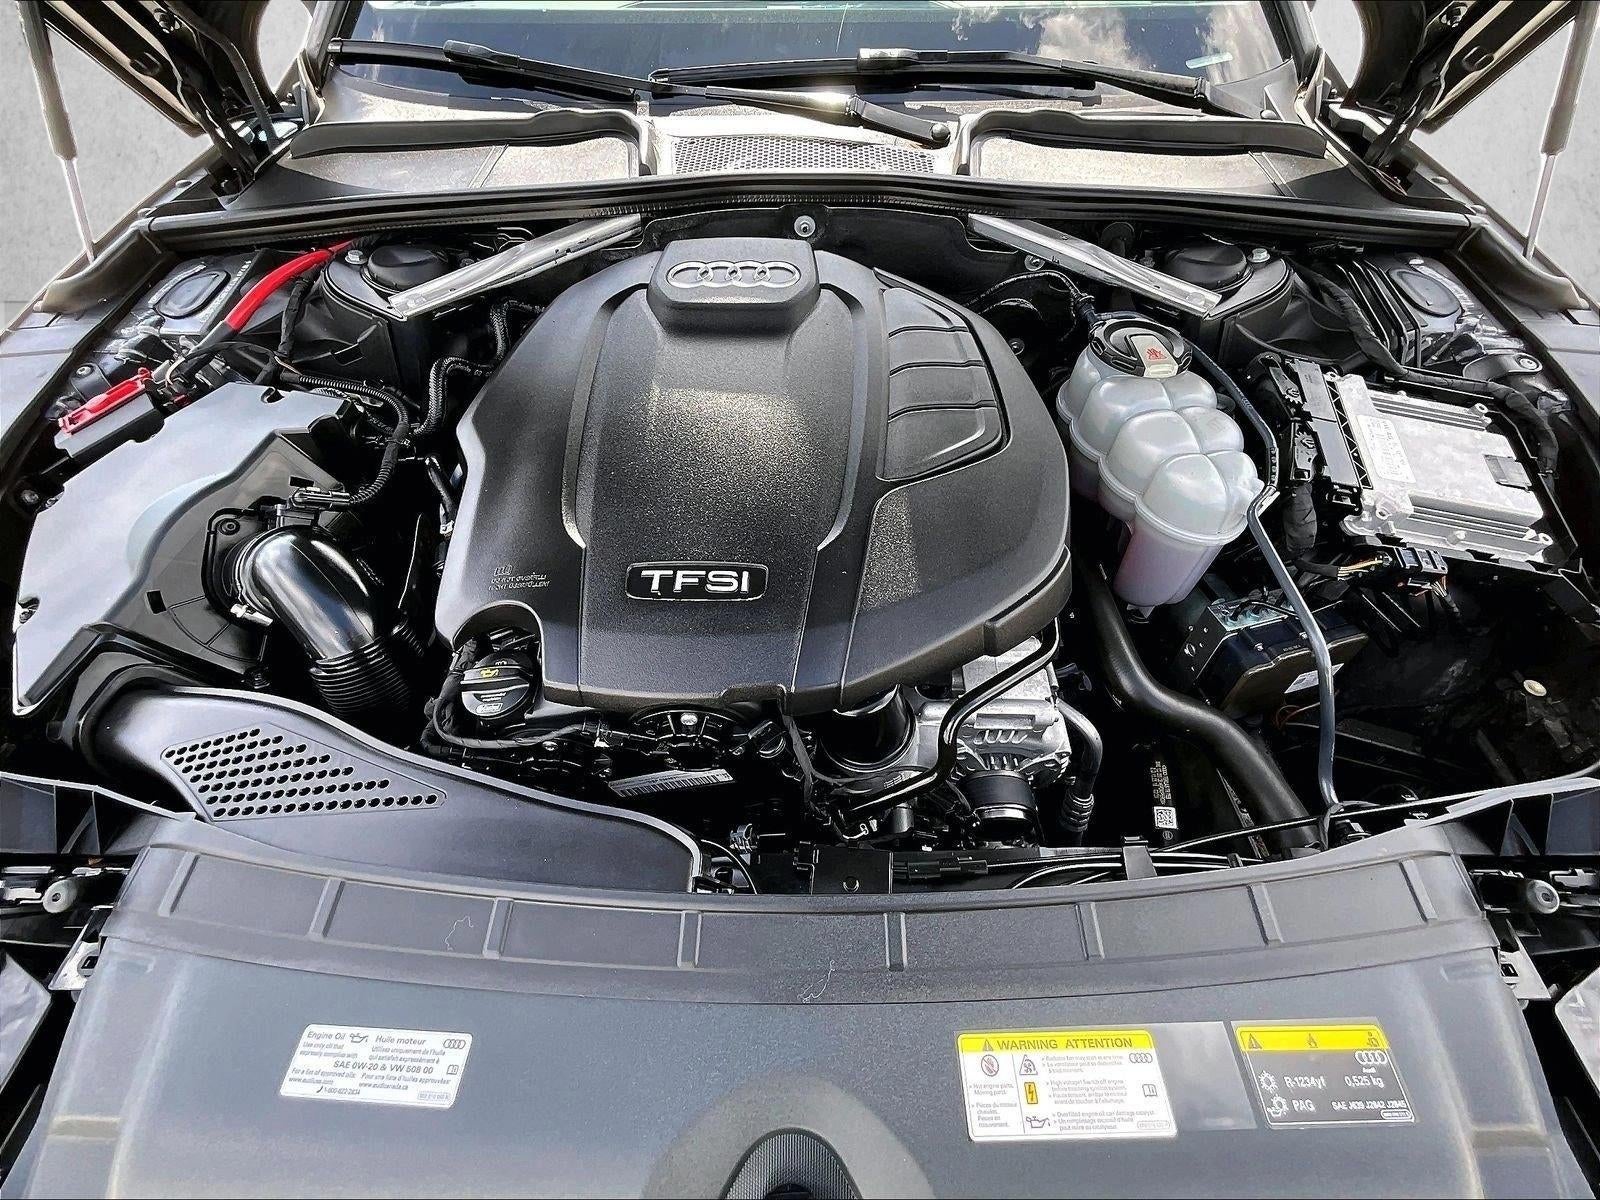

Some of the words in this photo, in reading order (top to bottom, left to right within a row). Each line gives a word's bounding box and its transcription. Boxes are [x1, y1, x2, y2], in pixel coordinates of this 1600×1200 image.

[641, 569, 749, 594] TFSI
[307, 1031, 332, 1040] Engine
[335, 1032, 346, 1040] Oil
[375, 1035, 394, 1043] Huile
[397, 1037, 426, 1045] moteur
[997, 1039, 1058, 1050] WARNING
[1065, 1037, 1132, 1049] ATTENTION
[352, 1062, 378, 1071] 0W-20
[390, 1064, 405, 1072] VW
[423, 1066, 434, 1074] 00
[1283, 1075, 1326, 1090] R-1234yf
[1344, 1075, 1370, 1087] 0,525
[1370, 1074, 1384, 1088] kg
[1292, 1099, 1316, 1112] PAG
[1332, 1101, 1347, 1110] SAE
